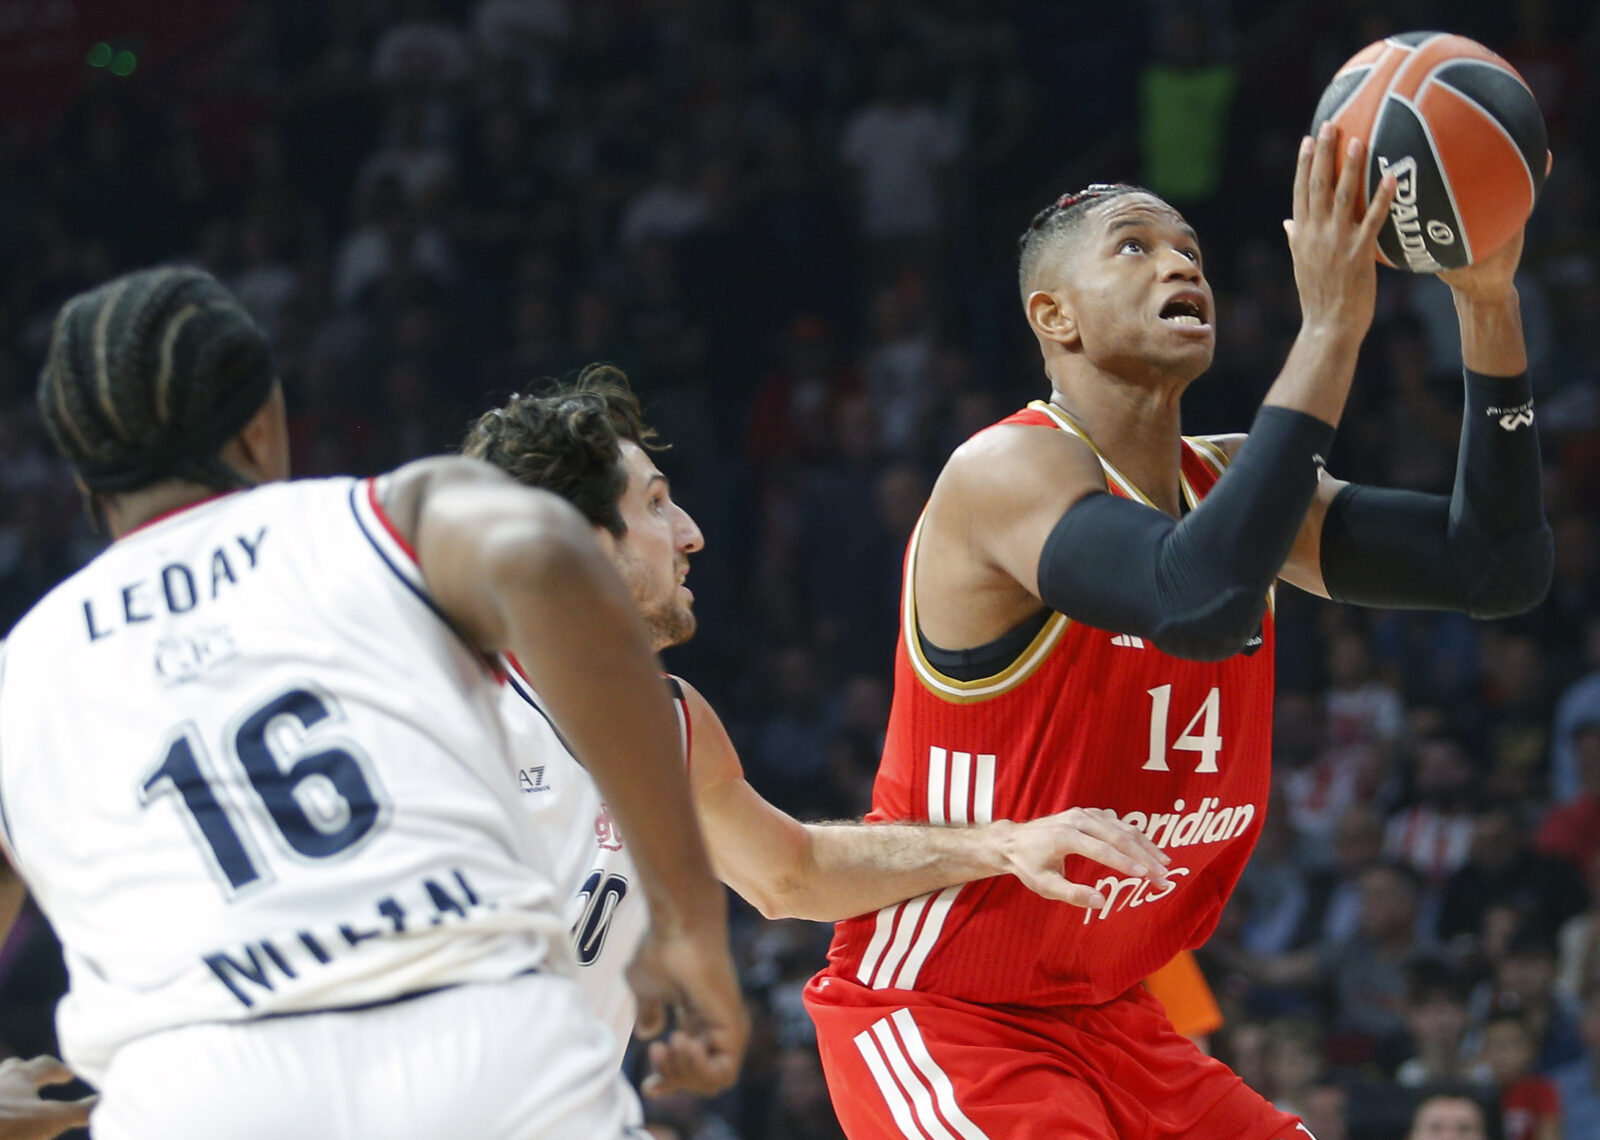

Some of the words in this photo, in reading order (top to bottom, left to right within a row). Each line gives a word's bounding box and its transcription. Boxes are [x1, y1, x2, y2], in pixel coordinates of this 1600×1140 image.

[83, 526, 269, 642] LEDAY
[1142, 683, 1222, 773] 14
[139, 682, 392, 903] 16
[1100, 797, 1255, 849] eridian
